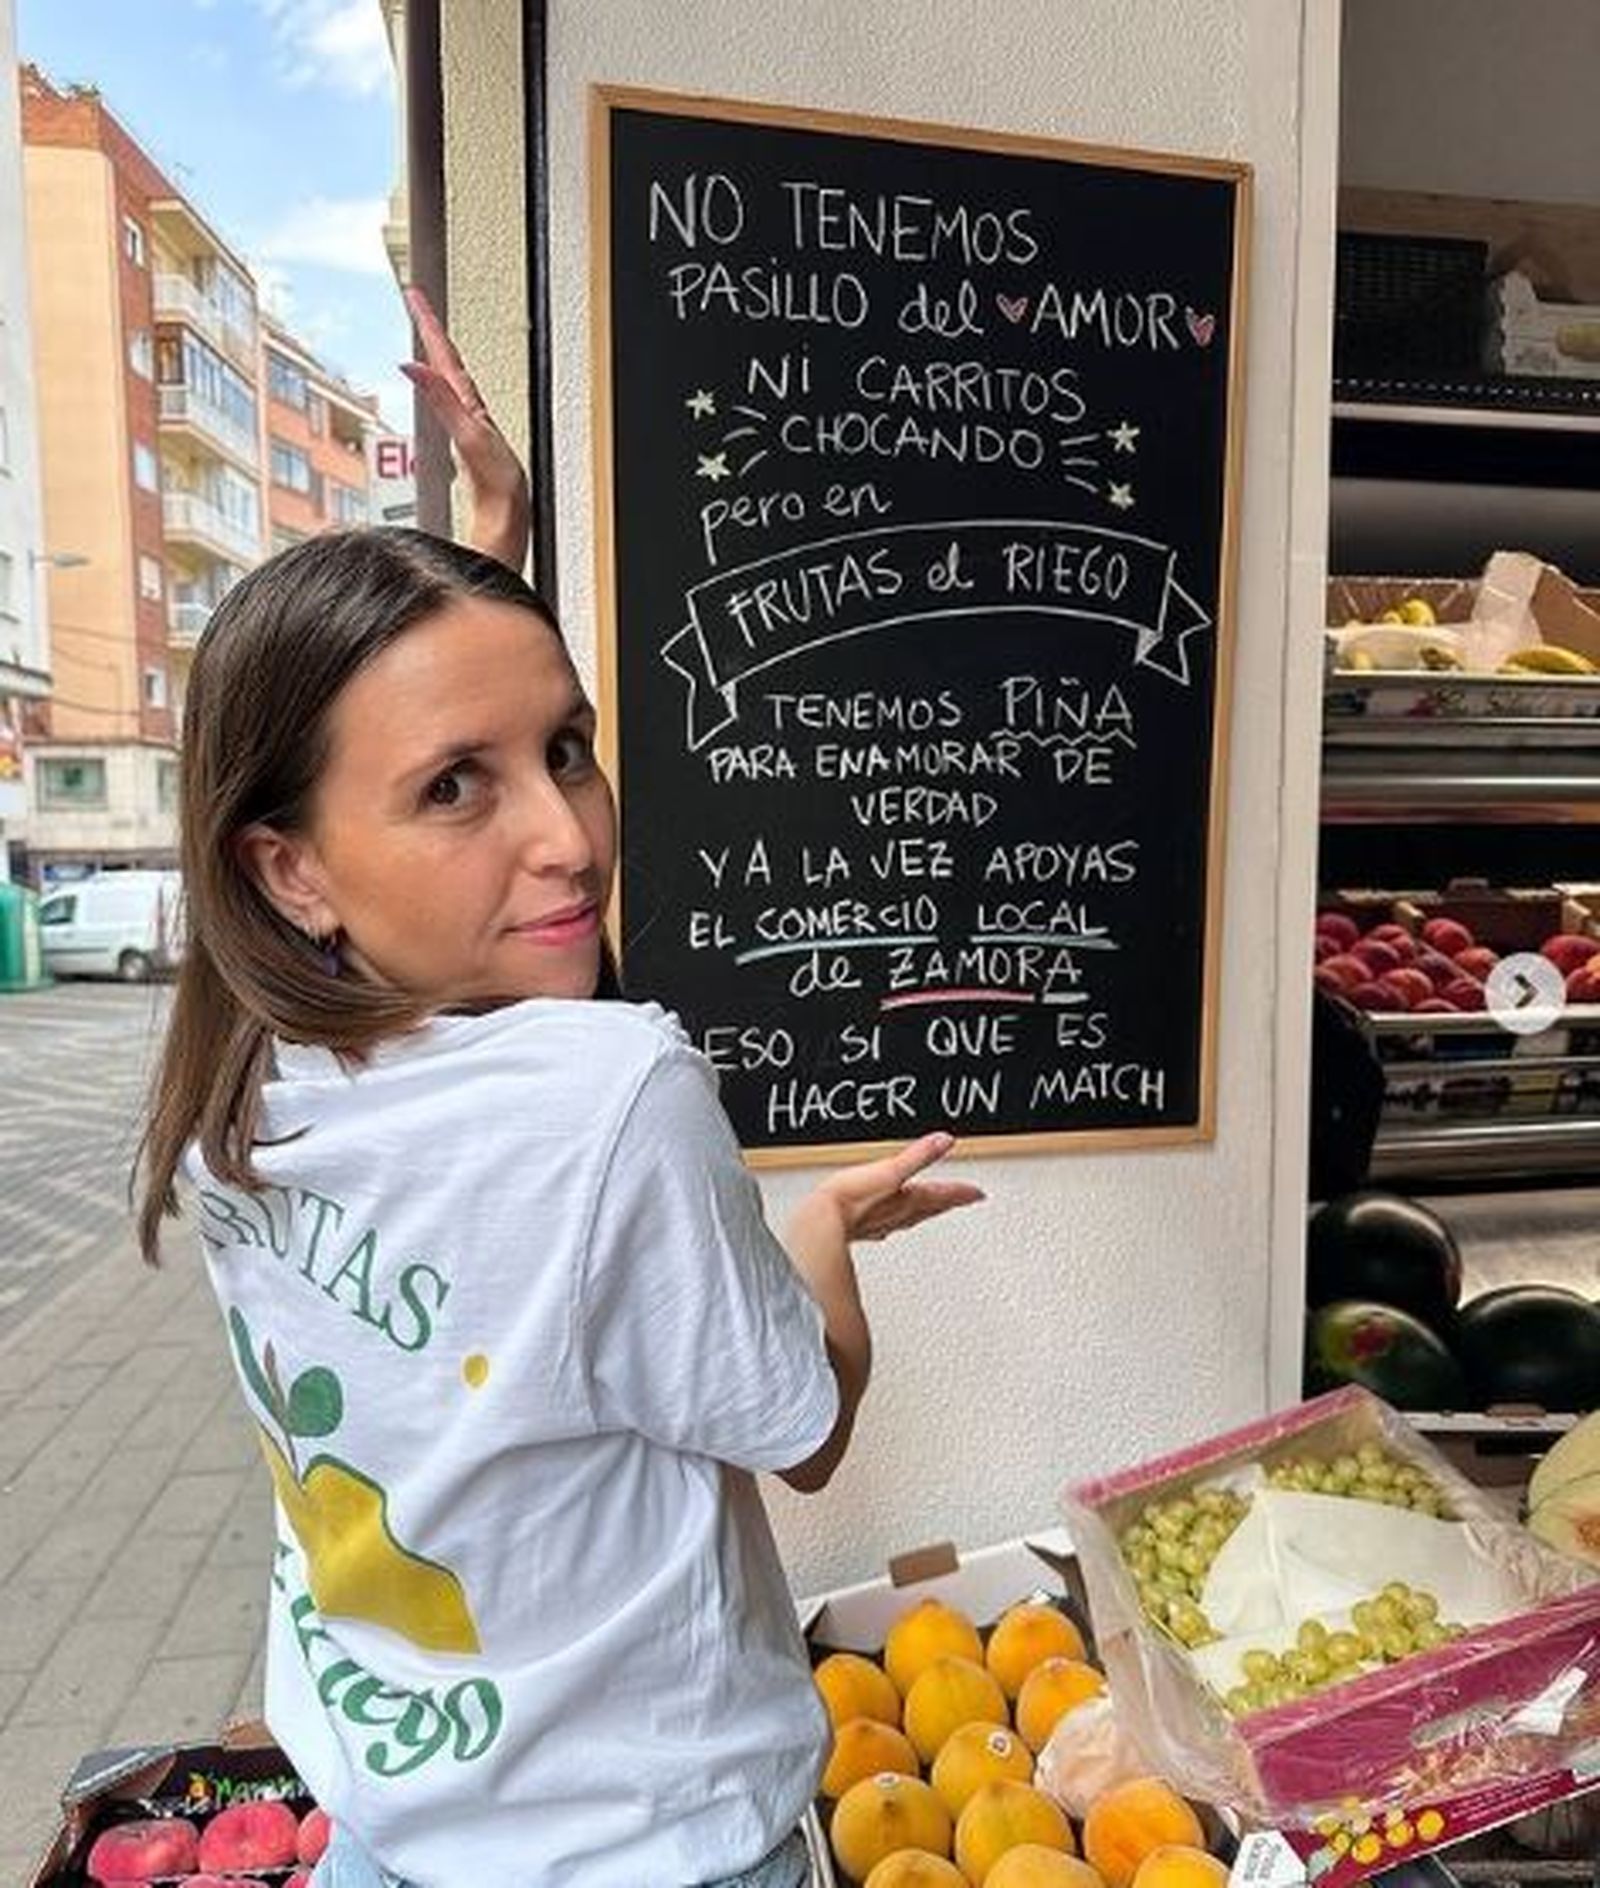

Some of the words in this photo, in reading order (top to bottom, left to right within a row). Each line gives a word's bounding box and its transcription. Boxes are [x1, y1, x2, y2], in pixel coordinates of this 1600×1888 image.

[650, 175, 743, 247] NO
[784, 183, 1037, 264] TENEMOS
[899, 281, 983, 337] del
[1031, 284, 1178, 349] AMOR
[856, 355, 1087, 424] CARRITOS
[781, 411, 1045, 469] CHOCANDO
[701, 488, 805, 566] pero
[824, 485, 891, 515] en
[727, 548, 904, 648] FRUTAS
[928, 542, 973, 590] el
[1003, 543, 1127, 599] RIEGO
[766, 691, 960, 729] TENEMOS
[999, 677, 1133, 732] PIÑA
[707, 744, 796, 782] PARA
[816, 740, 1020, 779] ENAMORAR
[1054, 748, 1111, 783] DE
[852, 786, 997, 826] VERDAD
[699, 849, 728, 888] Y
[746, 840, 770, 884] A
[803, 848, 849, 887] LA
[871, 838, 953, 878] VEZ
[986, 841, 1137, 885] APOYAS
[690, 912, 734, 949] EL
[756, 895, 937, 937] COMERCIO
[976, 902, 1107, 936] LOCAL
[785, 946, 861, 997] de
[889, 946, 1083, 991] ZAMORA
[704, 1026, 794, 1071] ESO
[841, 1026, 879, 1063] SI
[927, 1016, 1014, 1055] QUE
[1058, 1013, 1106, 1048] ES
[769, 1076, 916, 1132] HACER
[942, 1072, 1000, 1117] UN
[1030, 1063, 1163, 1109] MATCH
[200, 1186, 451, 1352] RUTAS
